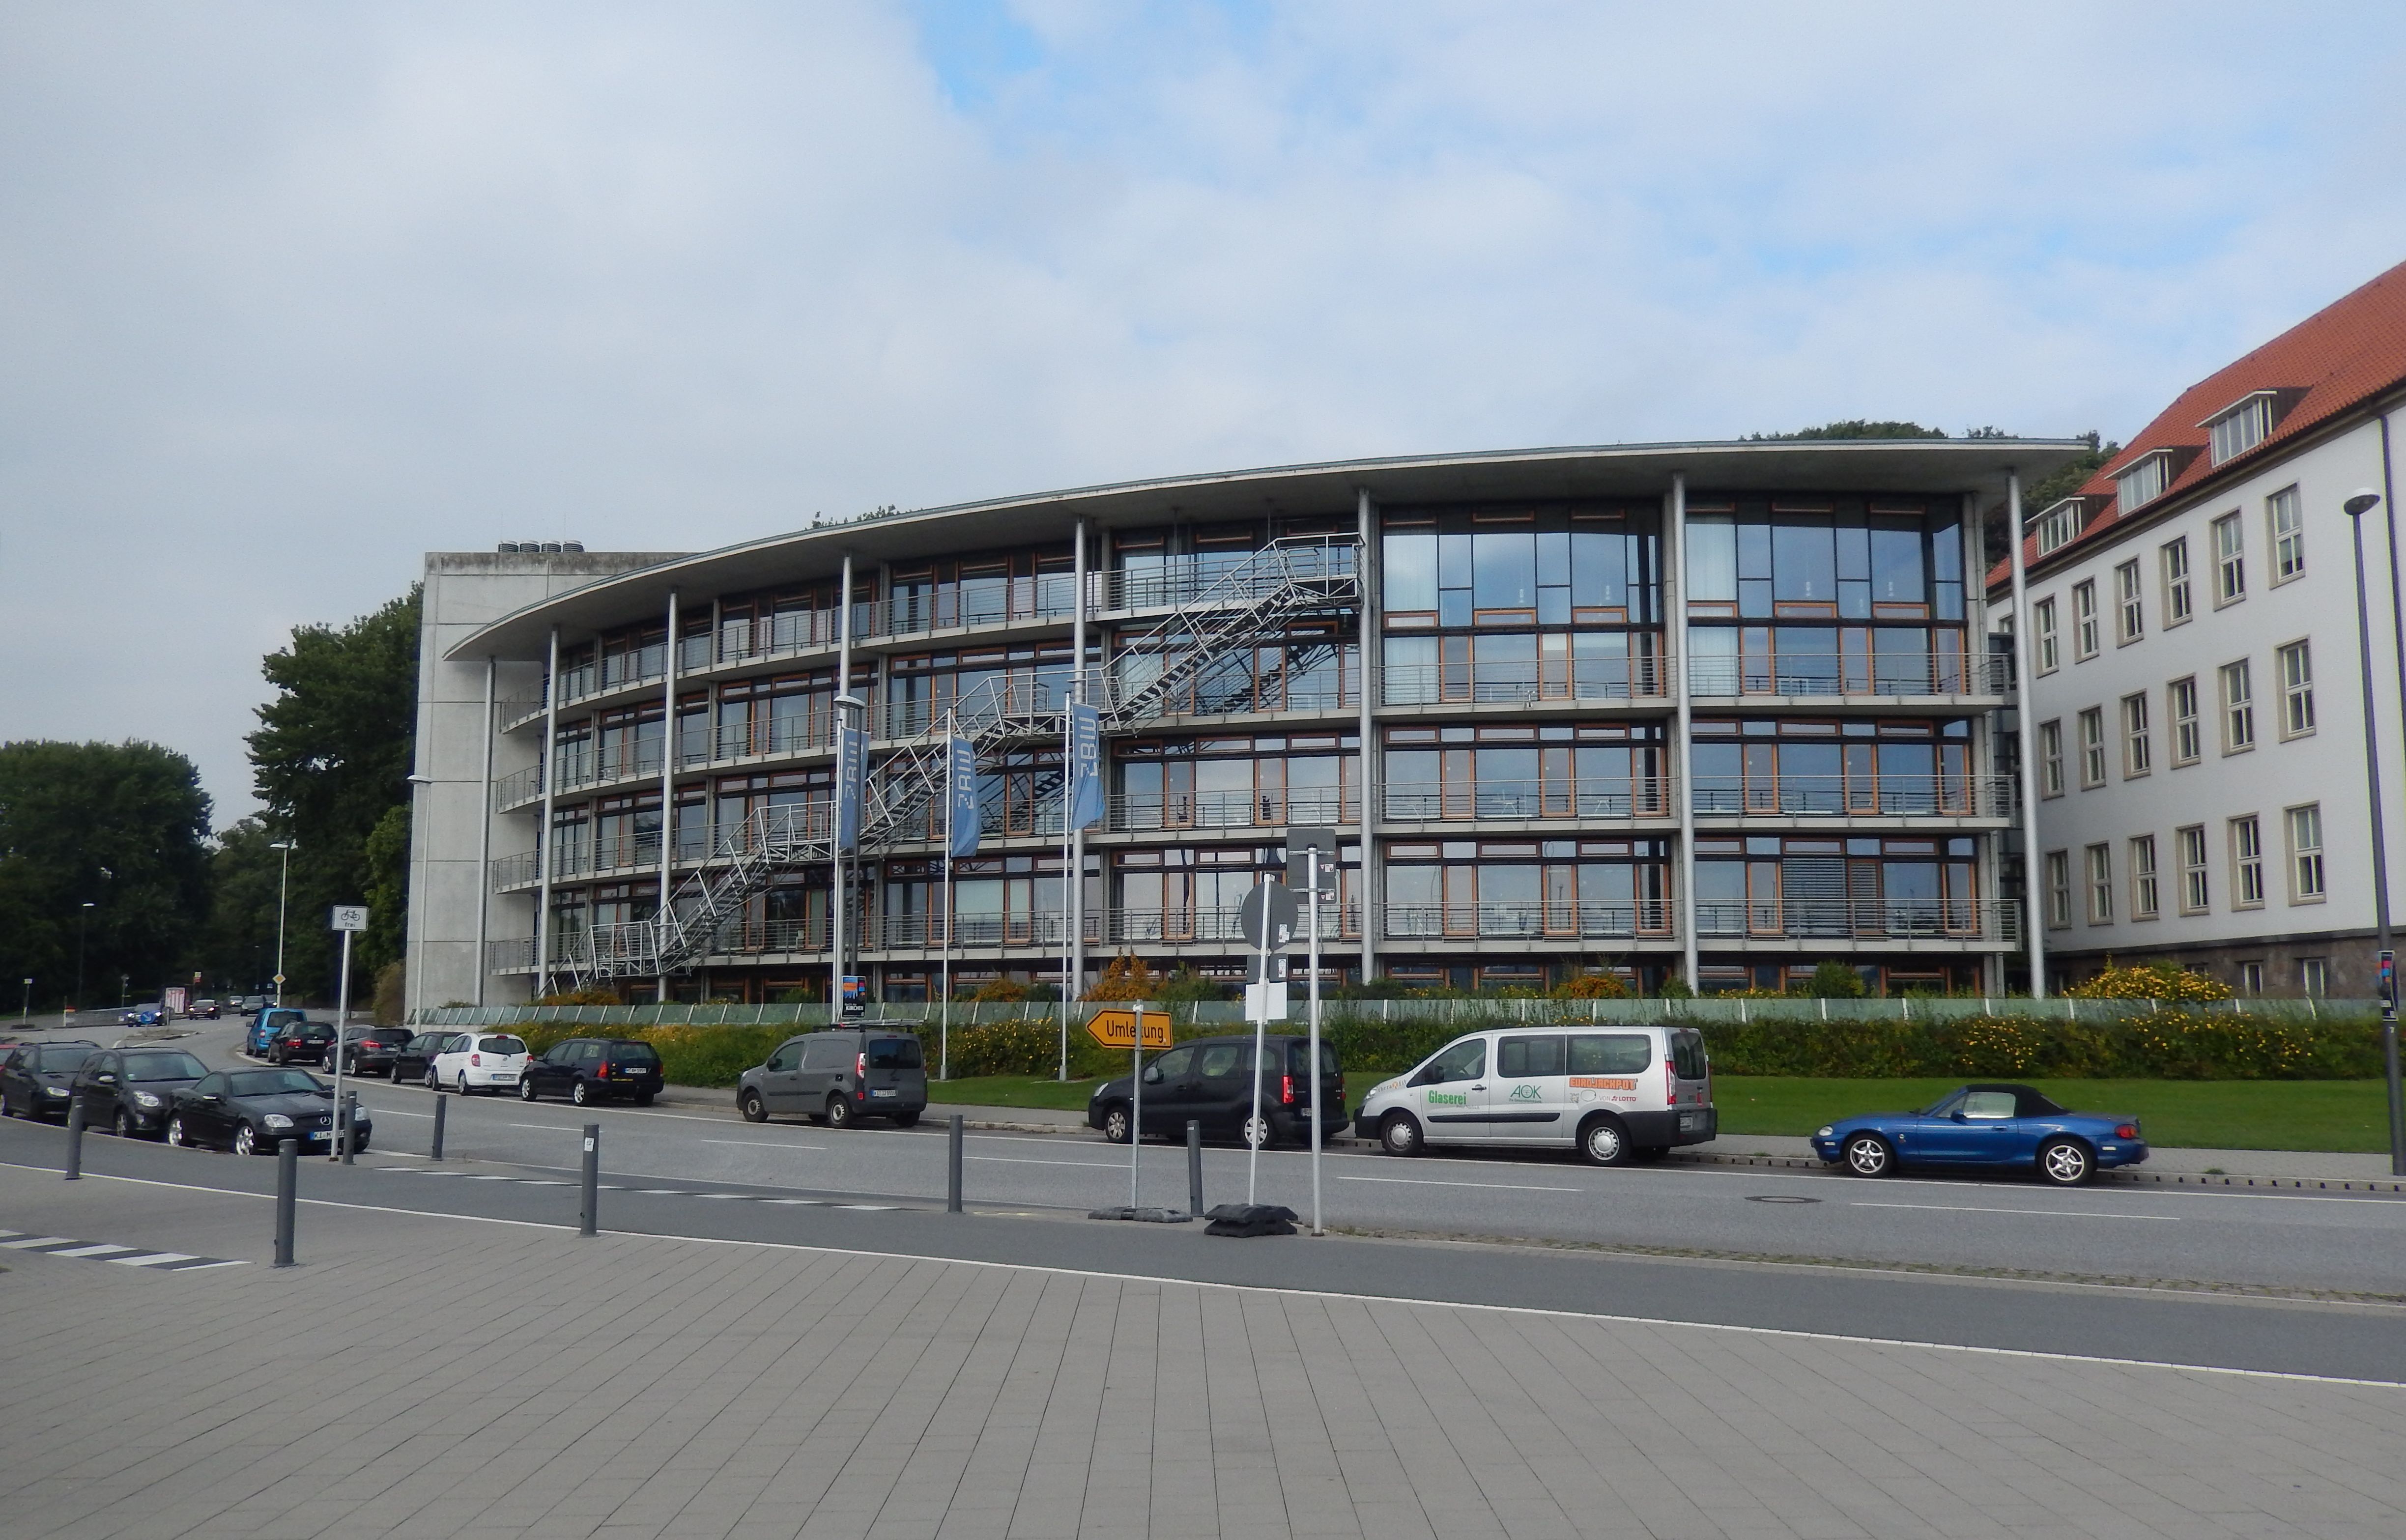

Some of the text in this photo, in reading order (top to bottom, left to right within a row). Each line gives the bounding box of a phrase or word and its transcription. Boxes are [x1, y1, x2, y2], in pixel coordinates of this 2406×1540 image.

[1078, 716, 1098, 777] ZBW
[1106, 1020, 1163, 1043] Umleung
[1510, 1084, 1542, 1099] AOK
[1569, 1077, 1638, 1091] EUROJACKPOT
[1428, 1090, 1466, 1105] Glaserei
